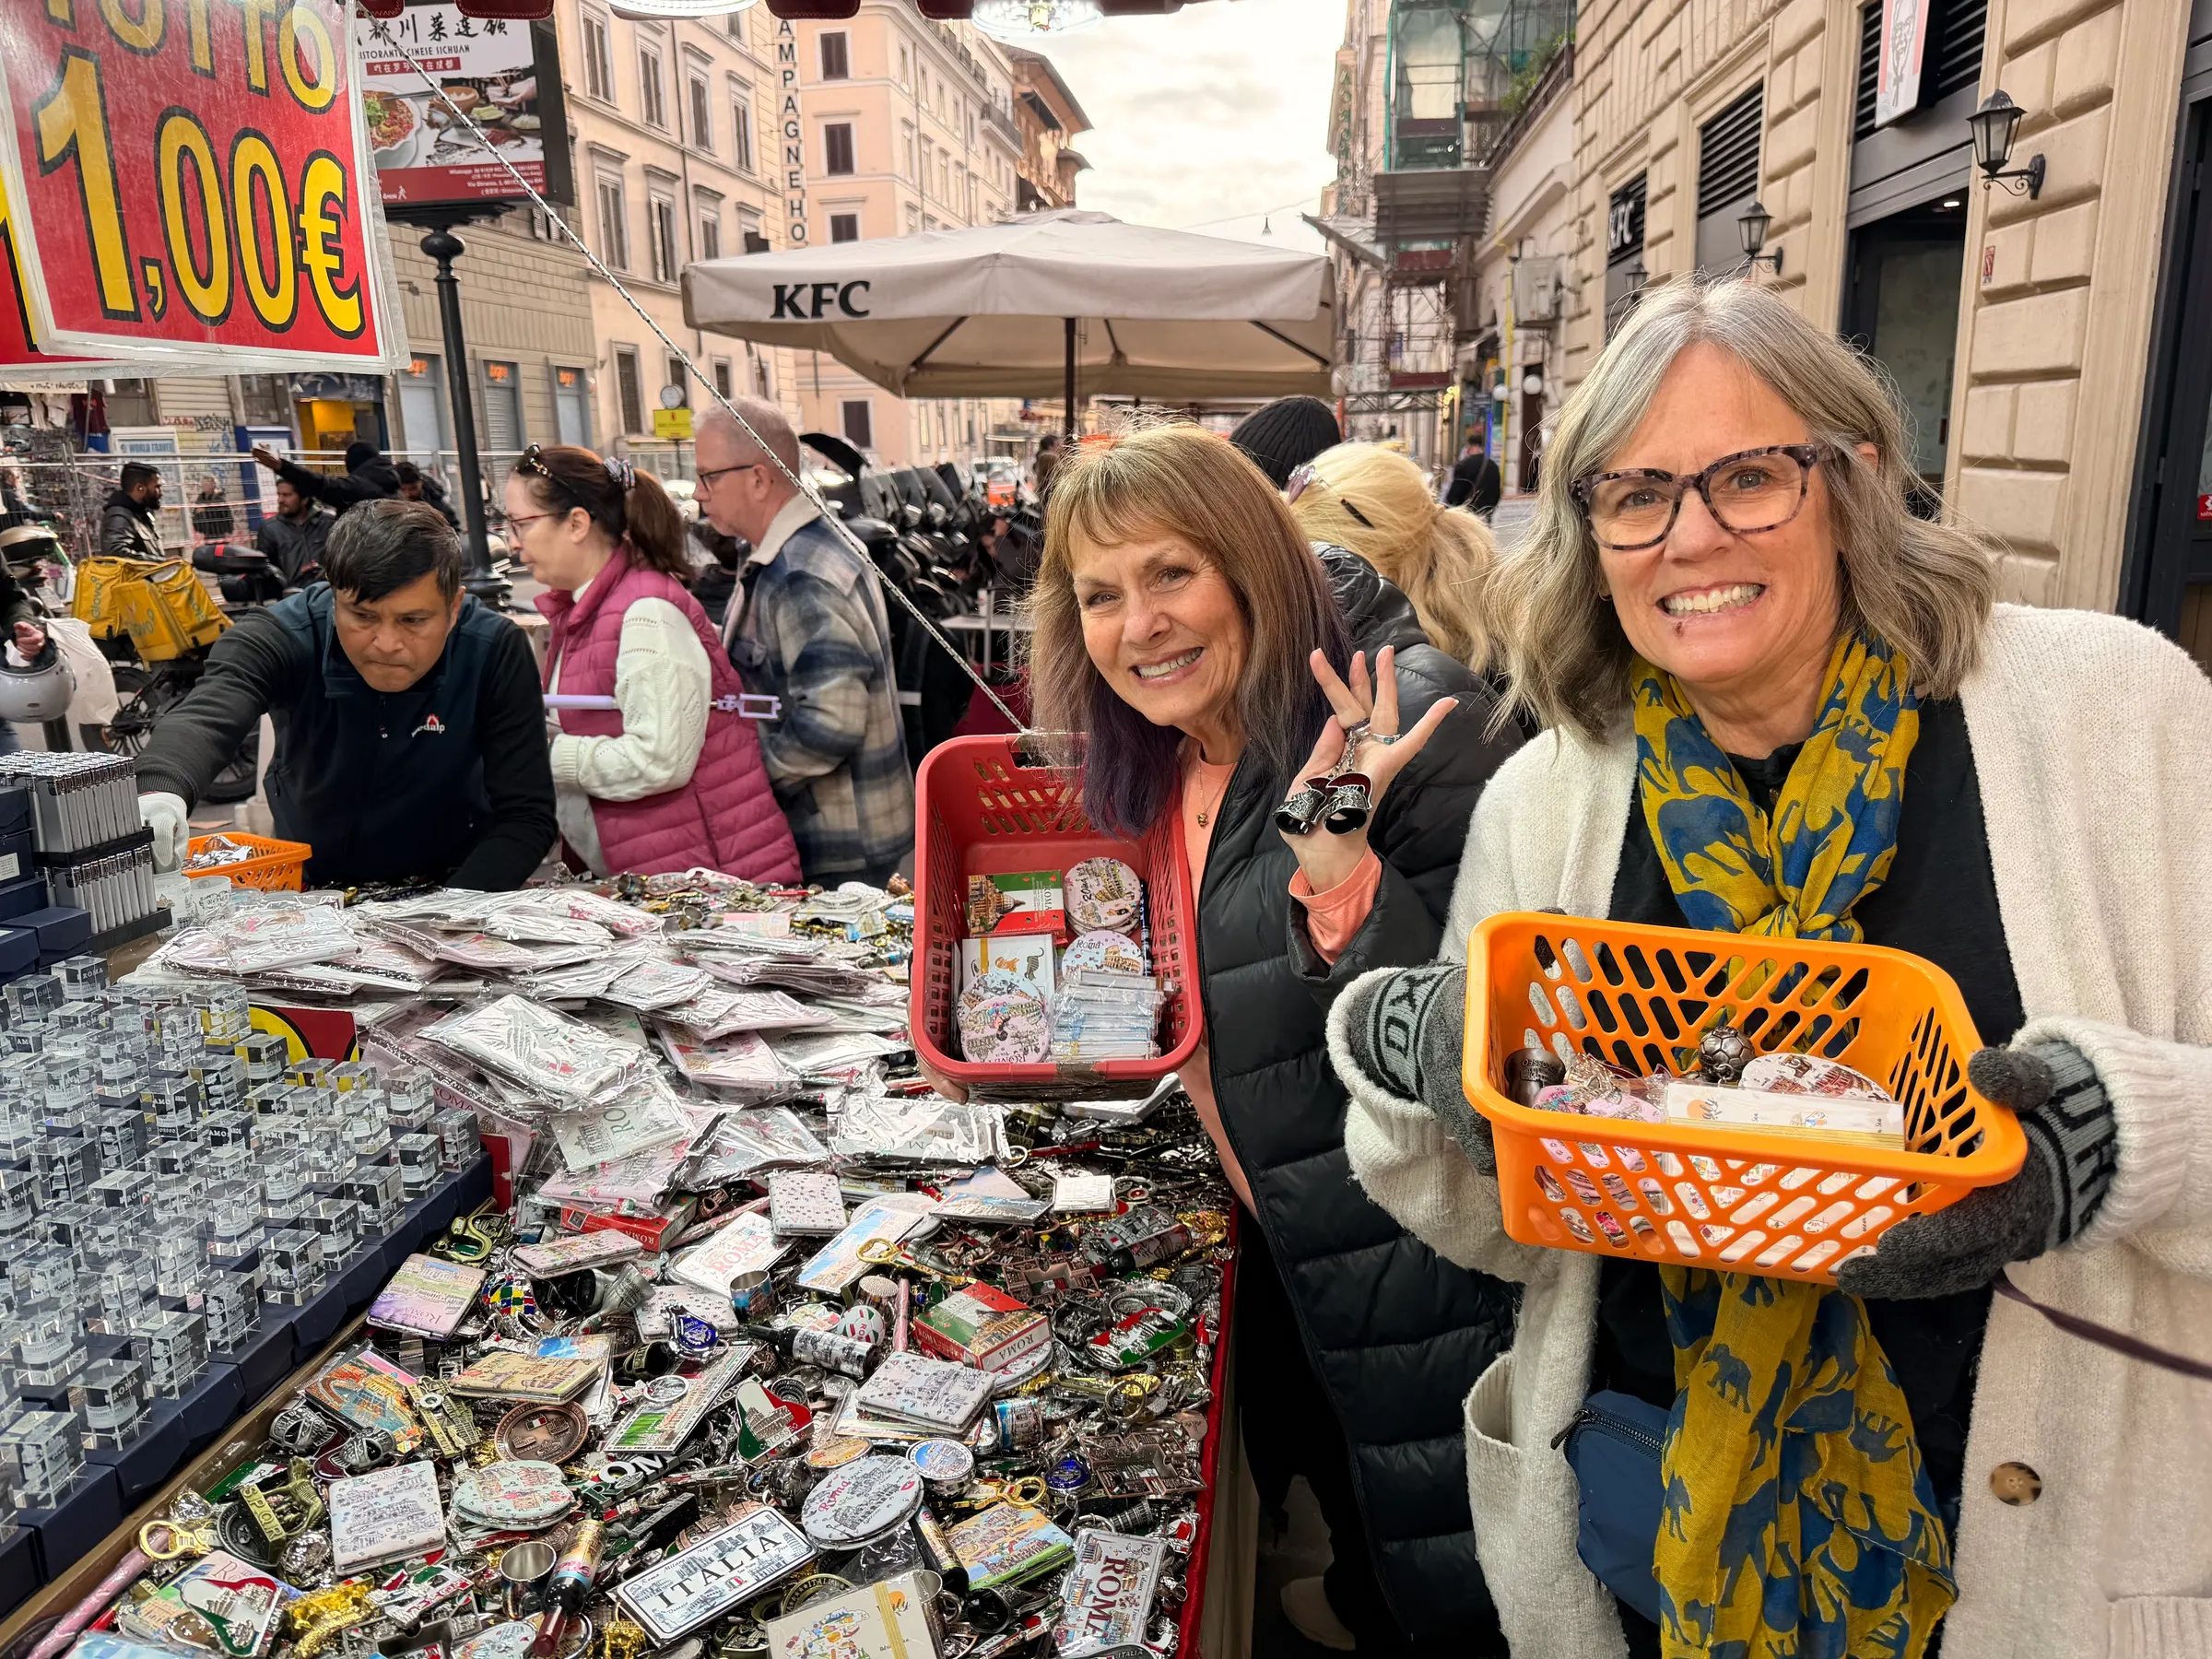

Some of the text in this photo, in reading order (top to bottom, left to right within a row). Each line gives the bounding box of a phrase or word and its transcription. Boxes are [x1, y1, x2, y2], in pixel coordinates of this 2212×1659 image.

[359, 49, 404, 60] ISTORANT
[437, 44, 470, 55] SICHUAN
[31, 42, 366, 339] 1,00€
[770, 280, 870, 319] KFC
[82, 967, 103, 980] ROMA
[433, 1086, 474, 1112] ROMA
[335, 1212, 356, 1230] ROMA
[711, 1234, 769, 1276] ROMA
[998, 1333, 1034, 1360] ROMA
[112, 1376, 138, 1401] ROMA
[759, 1422, 799, 1451] COLOSSEO
[352, 1465, 414, 1488] ROMA
[818, 1480, 852, 1512] Roma
[655, 1535, 782, 1608] ITALIA
[1082, 1555, 1129, 1639] ROMA
[1117, 1649, 1144, 1658] ITALIA
